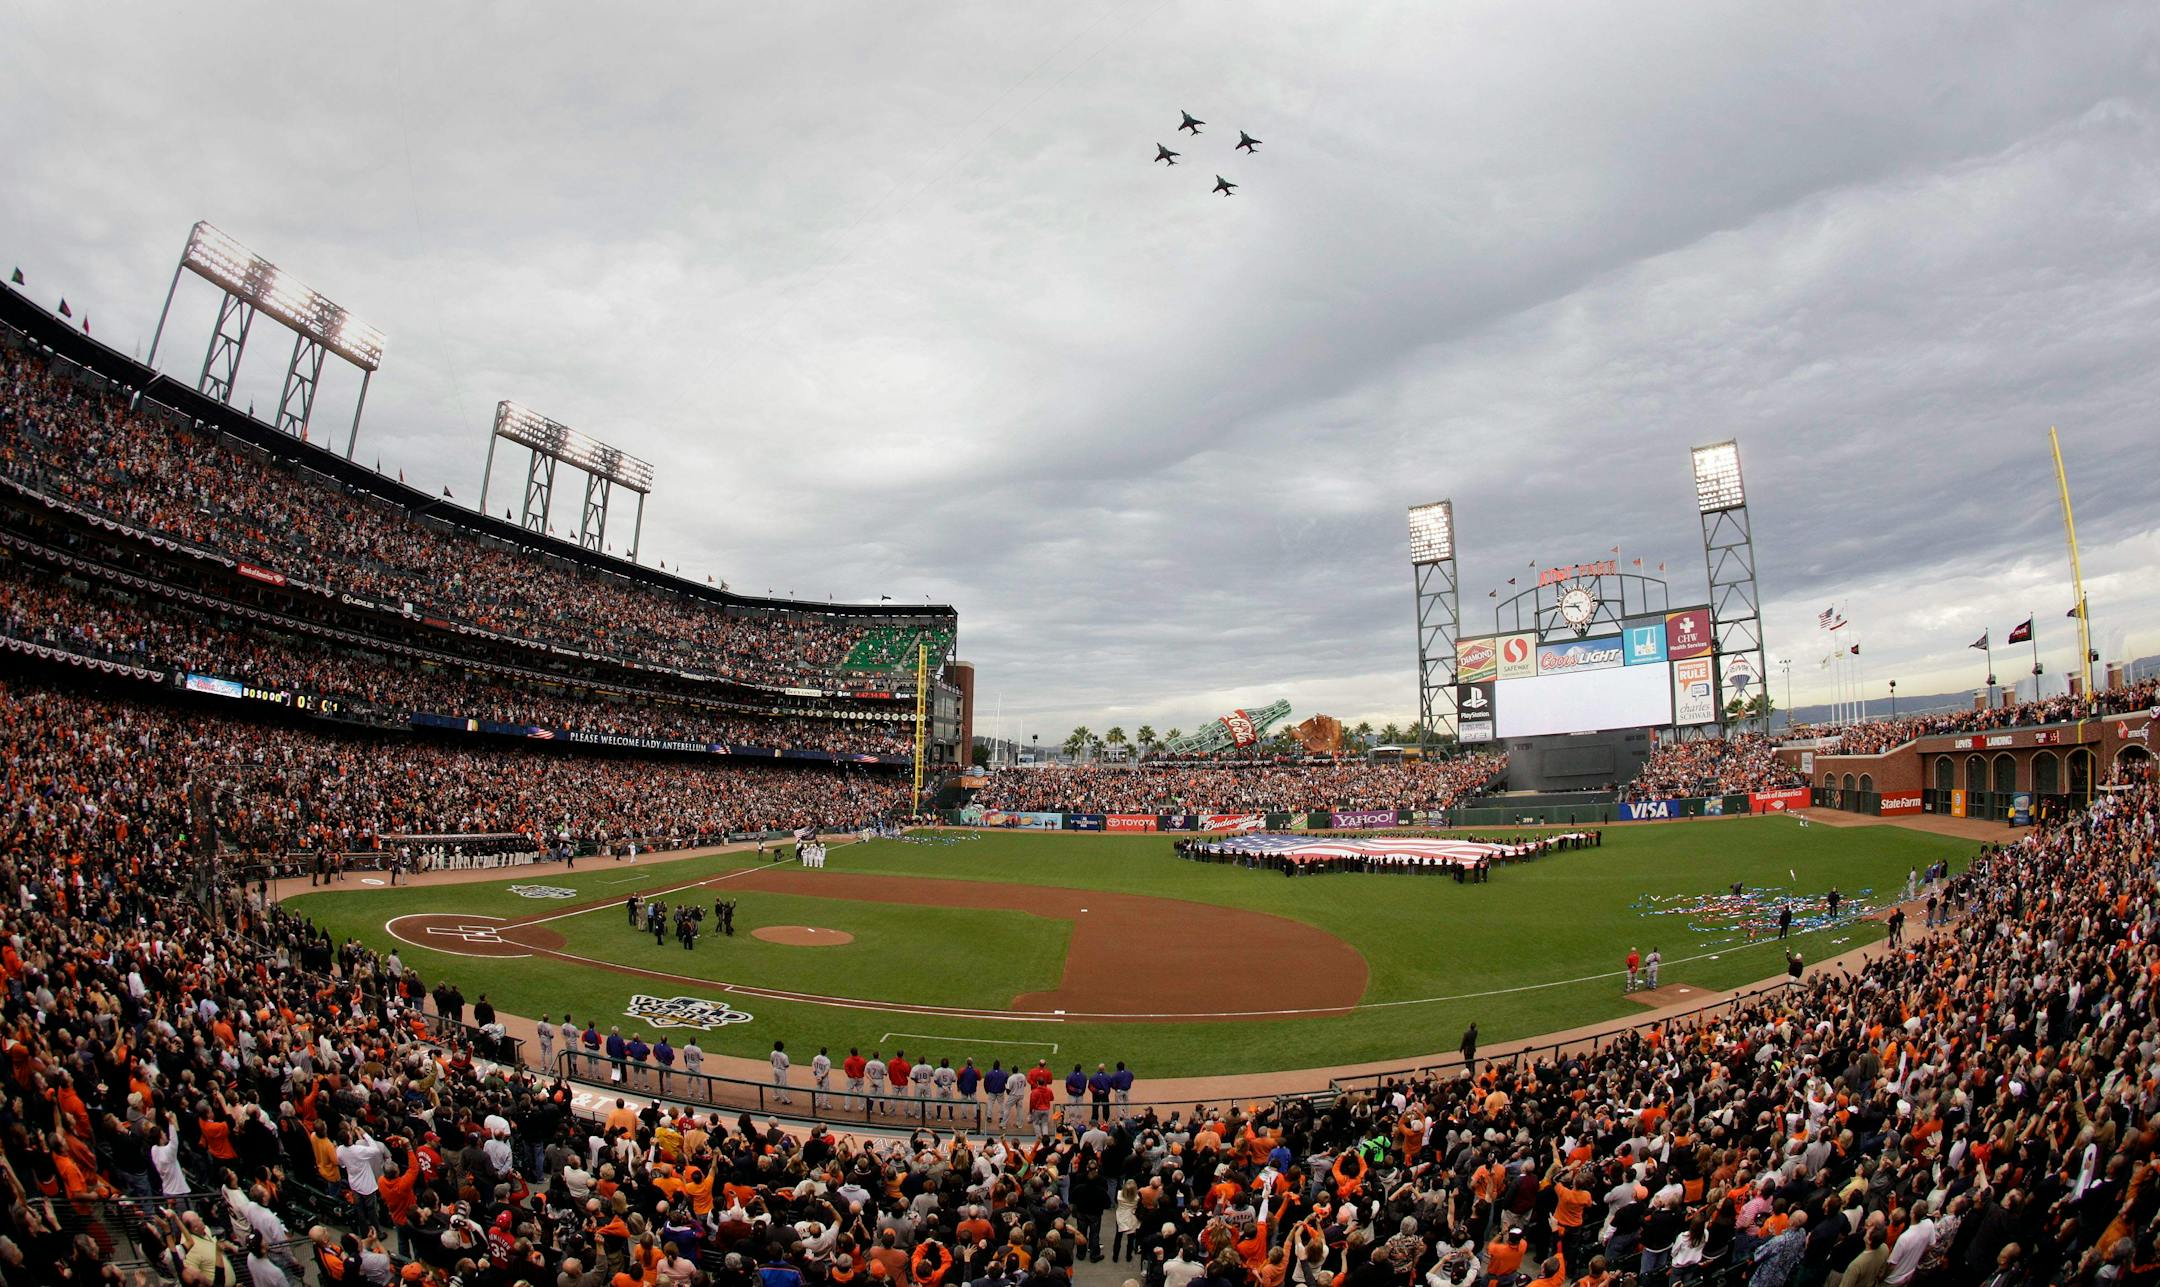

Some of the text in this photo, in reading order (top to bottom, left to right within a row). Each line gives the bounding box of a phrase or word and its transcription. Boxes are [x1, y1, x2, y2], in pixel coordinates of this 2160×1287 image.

[1562, 583, 1598, 607] FRANCISCO
[350, 598, 375, 609] LEXUS
[1677, 633, 1698, 643] CHW
[1670, 643, 1687, 651] Health
[1460, 649, 1493, 666] DIAMOND
[1541, 652, 1578, 669] Coors
[1577, 649, 1619, 665] LIGHT
[1503, 664, 1529, 673] SAFEWAY
[1679, 669, 1707, 680] RULE
[1680, 702, 1711, 713] charles
[1460, 711, 1489, 719] PlayStation
[1680, 711, 1712, 721] SCHWAB
[570, 732, 707, 752] PLEASE WELCOME LADY ANTEBELLUM
[1755, 792, 1770, 800] Bank
[1777, 789, 1802, 798] America
[1880, 798, 1900, 810] State
[1900, 797, 1921, 808] Farm
[1628, 802, 1668, 819] VISA
[1120, 818, 1156, 827] TOYOTA
[1203, 814, 1257, 831] Budweiser
[1333, 811, 1393, 828] YAHOO!
[630, 995, 753, 1022] WORLD
[491, 1242, 508, 1262] 32
